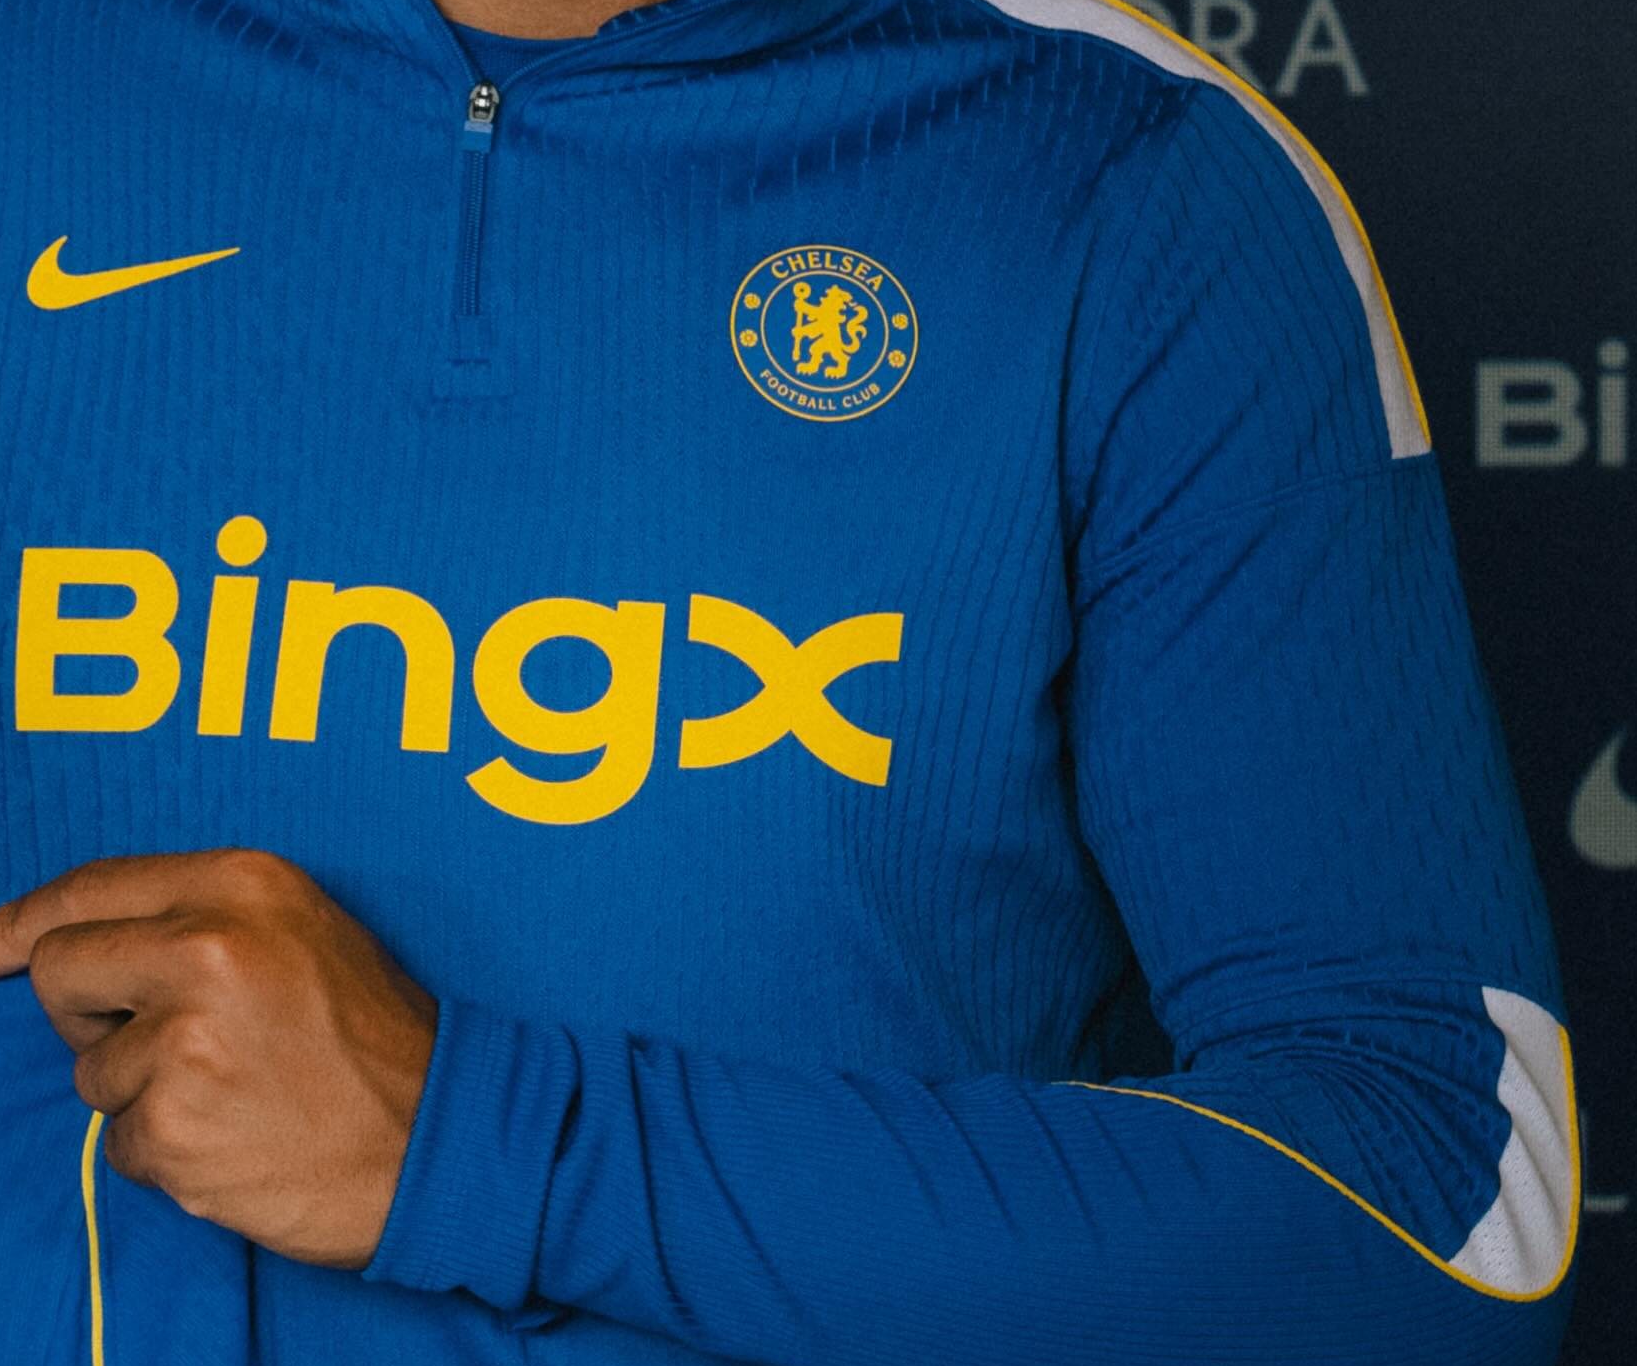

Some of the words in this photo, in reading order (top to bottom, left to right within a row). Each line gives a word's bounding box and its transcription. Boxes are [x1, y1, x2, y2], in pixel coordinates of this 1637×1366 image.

[771, 251, 883, 292] CHELSEA
[760, 369, 837, 411] FOOTBALL
[842, 383, 881, 409] CLUB
[14, 515, 905, 826] Bingx
